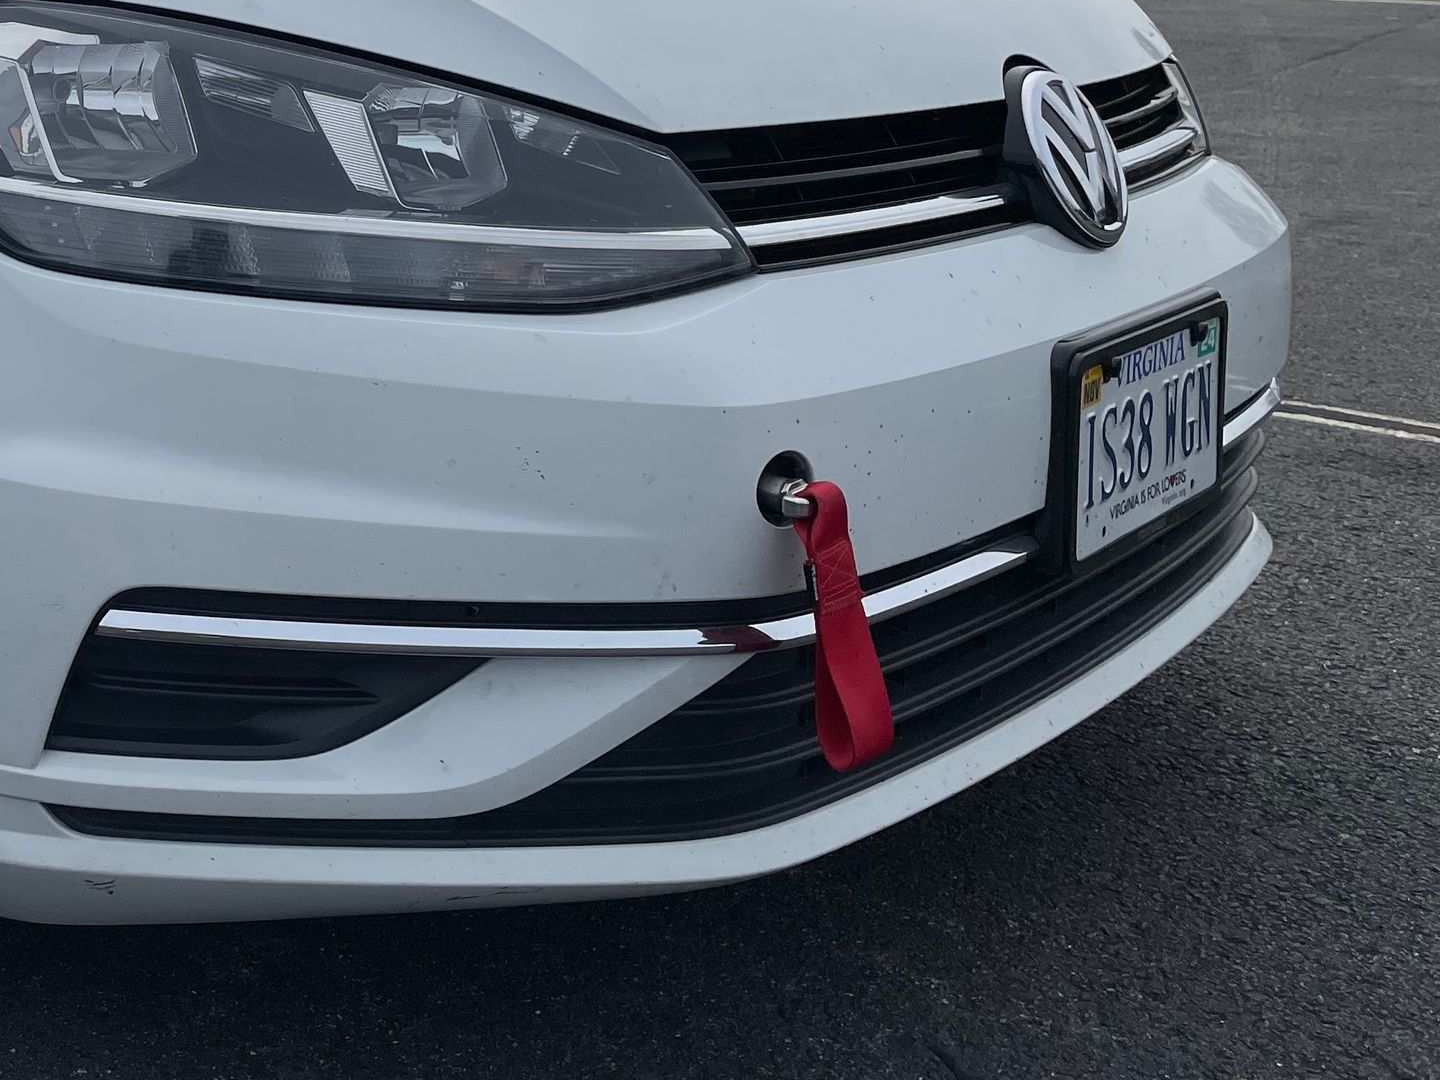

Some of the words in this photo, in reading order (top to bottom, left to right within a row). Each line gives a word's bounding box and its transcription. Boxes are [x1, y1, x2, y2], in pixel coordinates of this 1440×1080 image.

[1116, 331, 1186, 388] VIRGINIA
[1084, 388, 1154, 510] IS38
[1163, 361, 1213, 467] WGN
[1109, 493, 1140, 519] VIRGINIA
[1146, 482, 1162, 500] FOR
